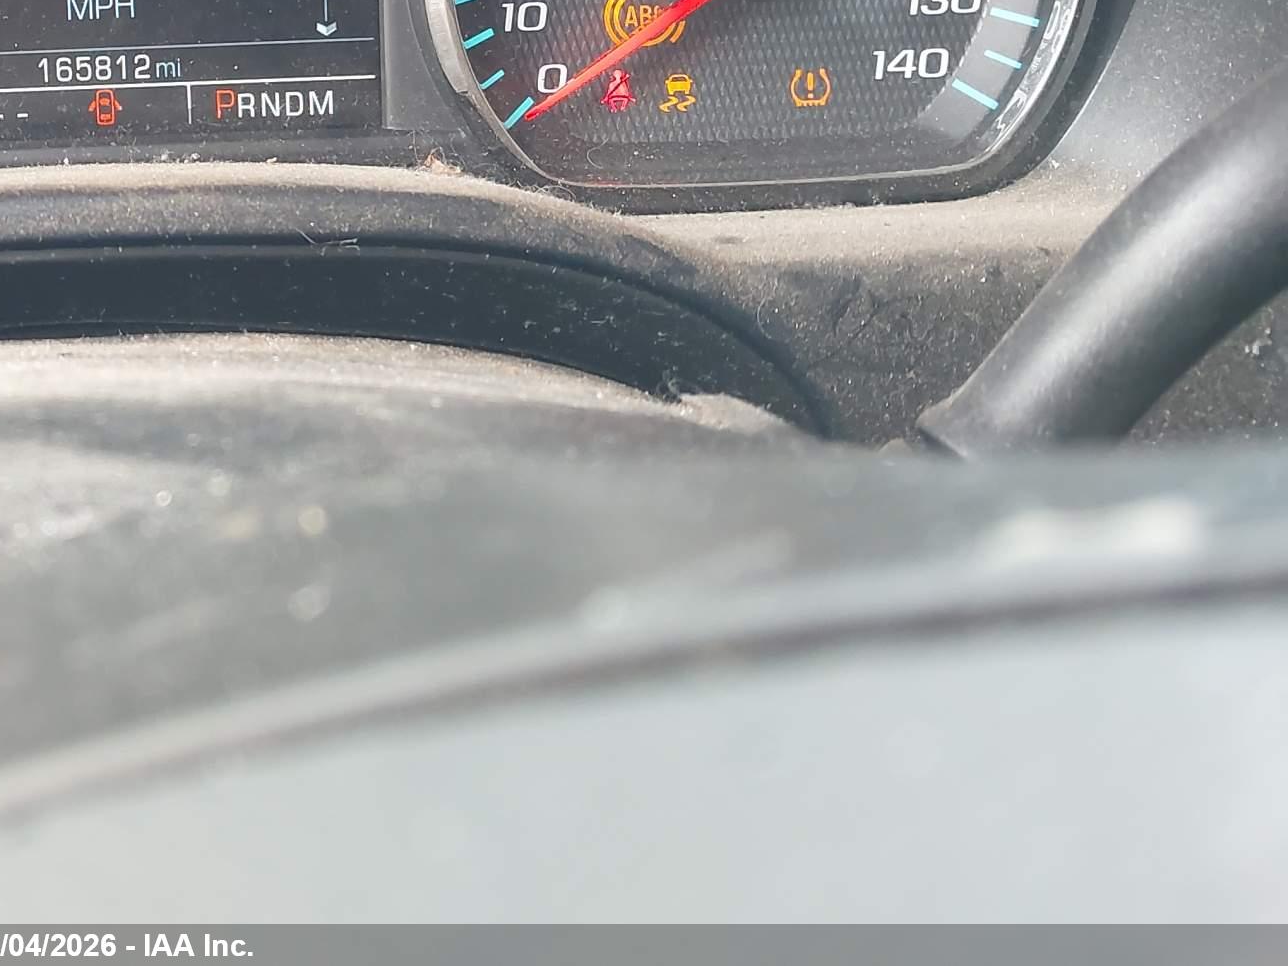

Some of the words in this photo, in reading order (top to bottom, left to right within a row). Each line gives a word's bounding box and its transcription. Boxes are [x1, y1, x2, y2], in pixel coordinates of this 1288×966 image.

[501, 2, 547, 32] 10
[37, 53, 151, 84] 165812
[155, 58, 182, 80] mi
[537, 64, 568, 94] 0
[873, 48, 948, 80] 140
